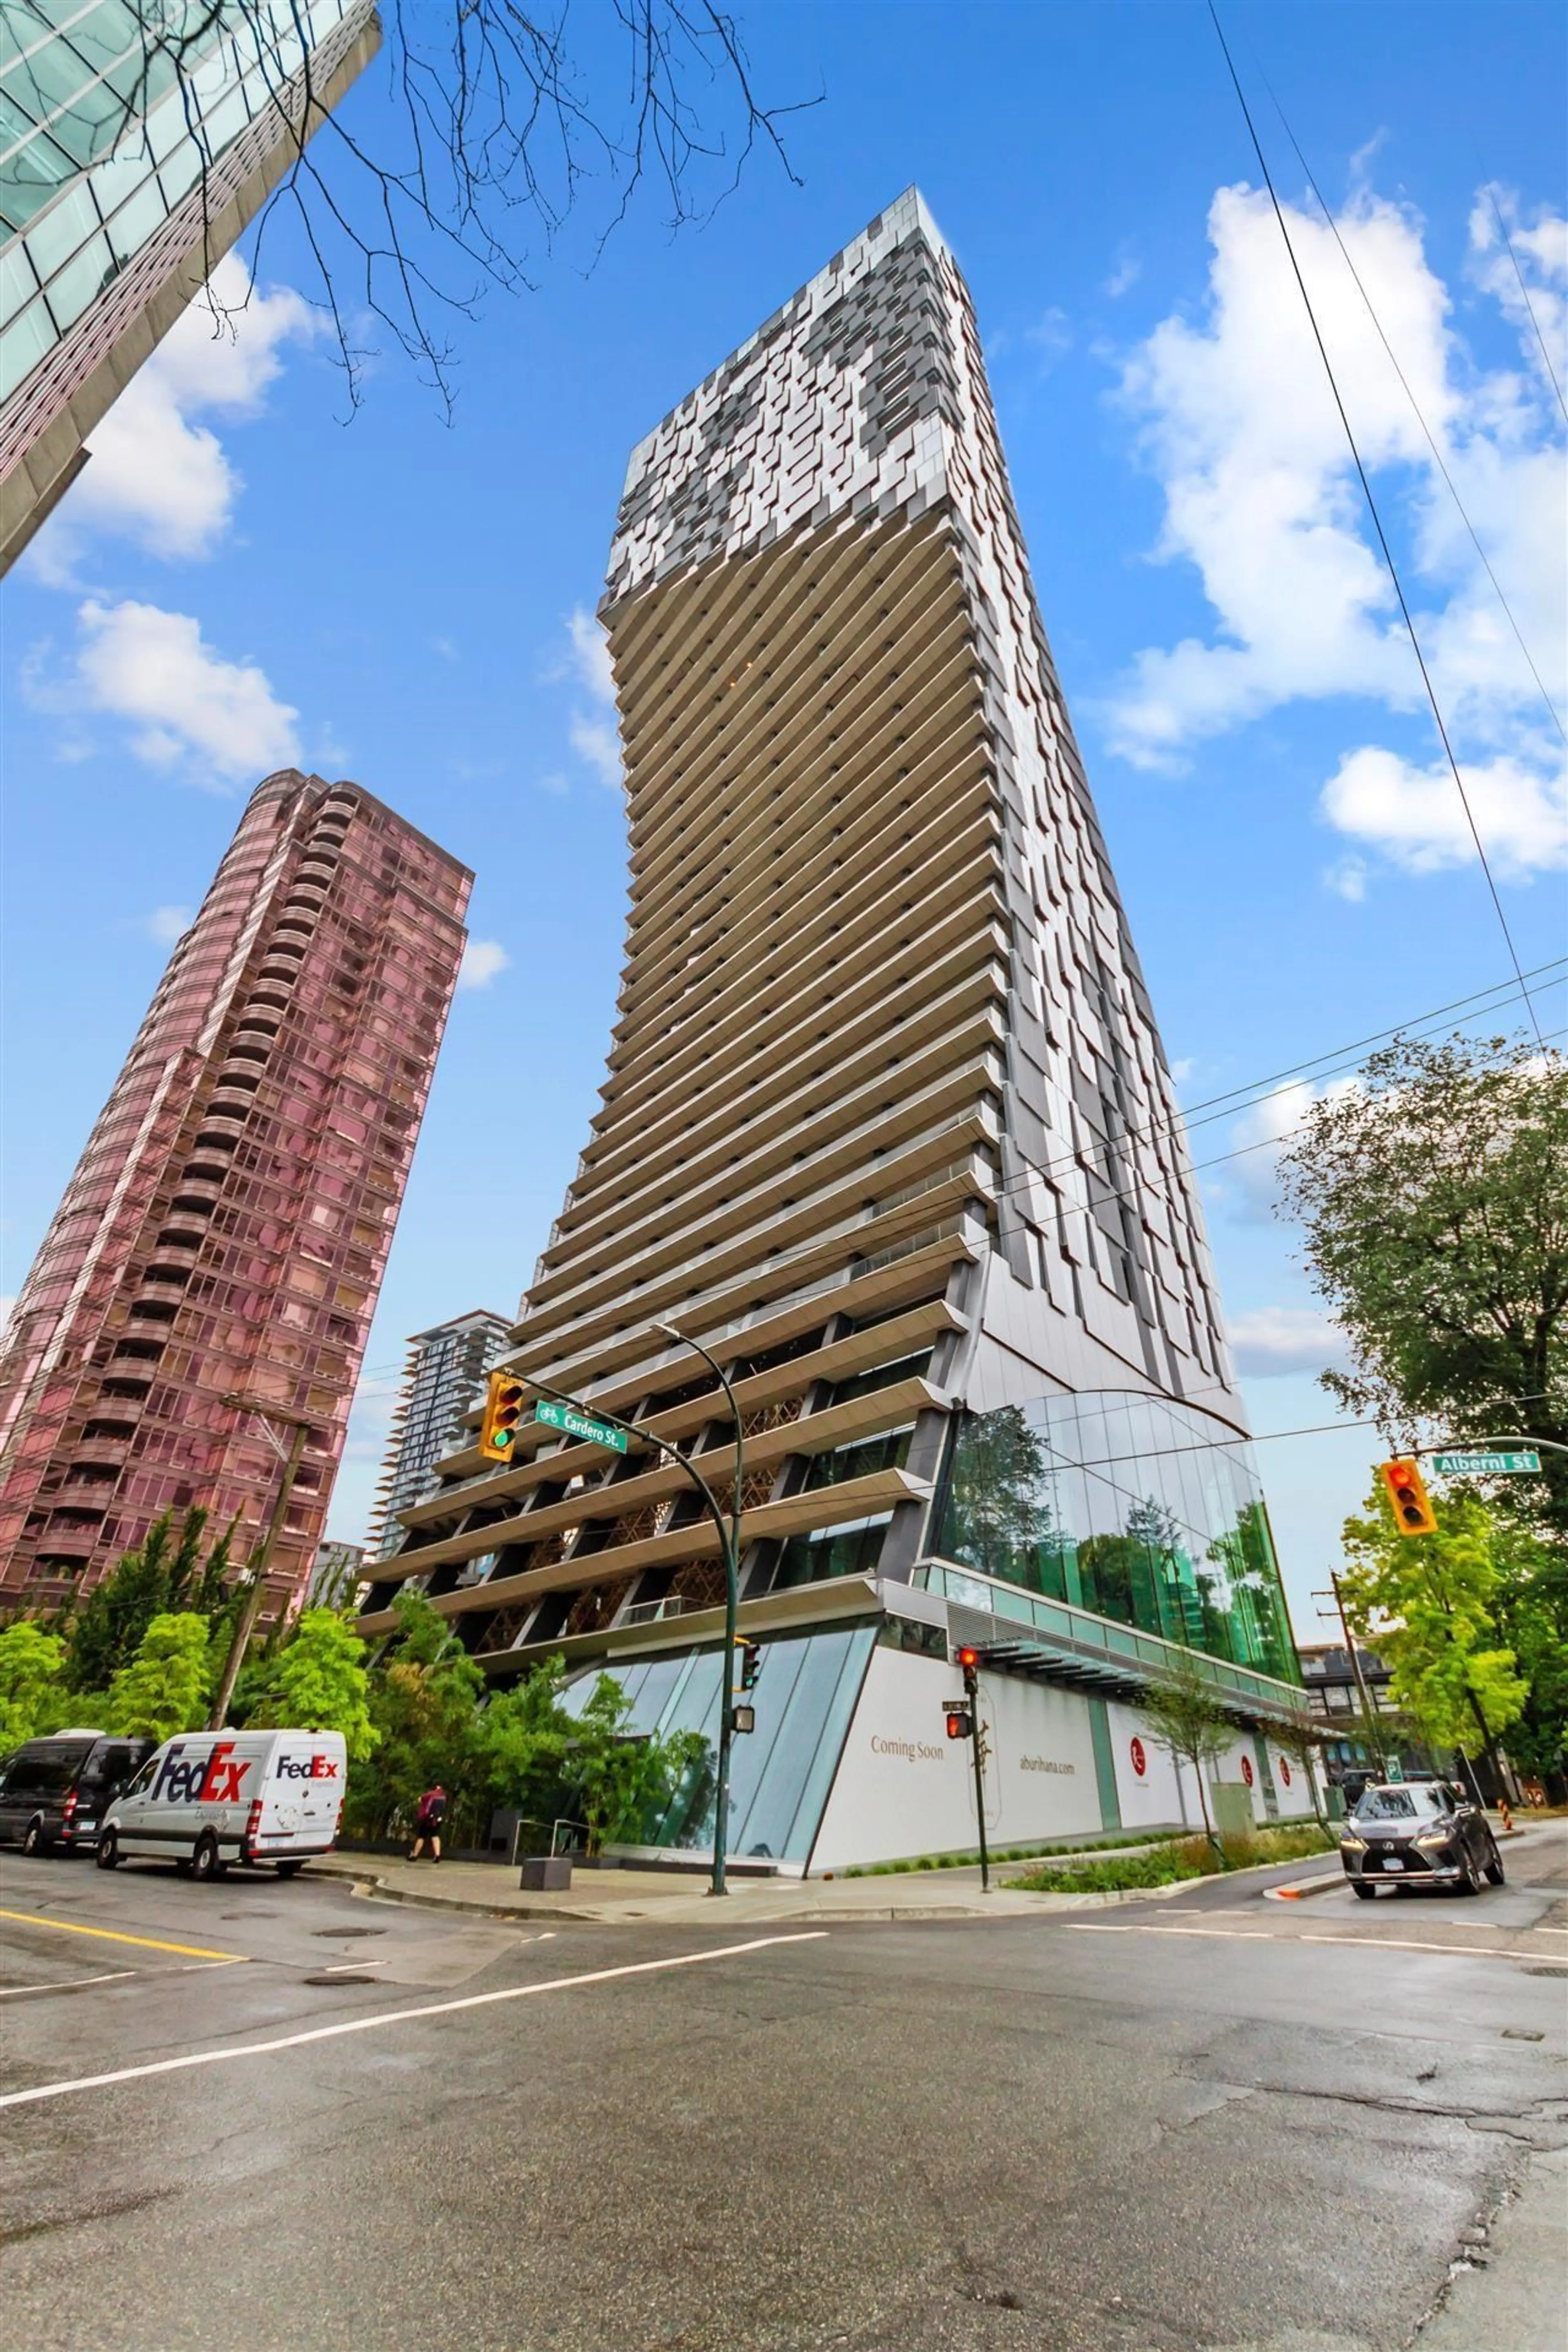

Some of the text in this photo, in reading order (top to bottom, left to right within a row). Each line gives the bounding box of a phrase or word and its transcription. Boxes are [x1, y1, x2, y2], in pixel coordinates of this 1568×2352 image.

[564, 1414, 619, 1447] Cardero St.
[1441, 1455, 1532, 1471] Alberni St
[871, 1735, 915, 1762] Coming
[917, 1741, 944, 1760] Soon
[151, 1742, 252, 1803] FedEx
[276, 1755, 338, 1779] FedEx
